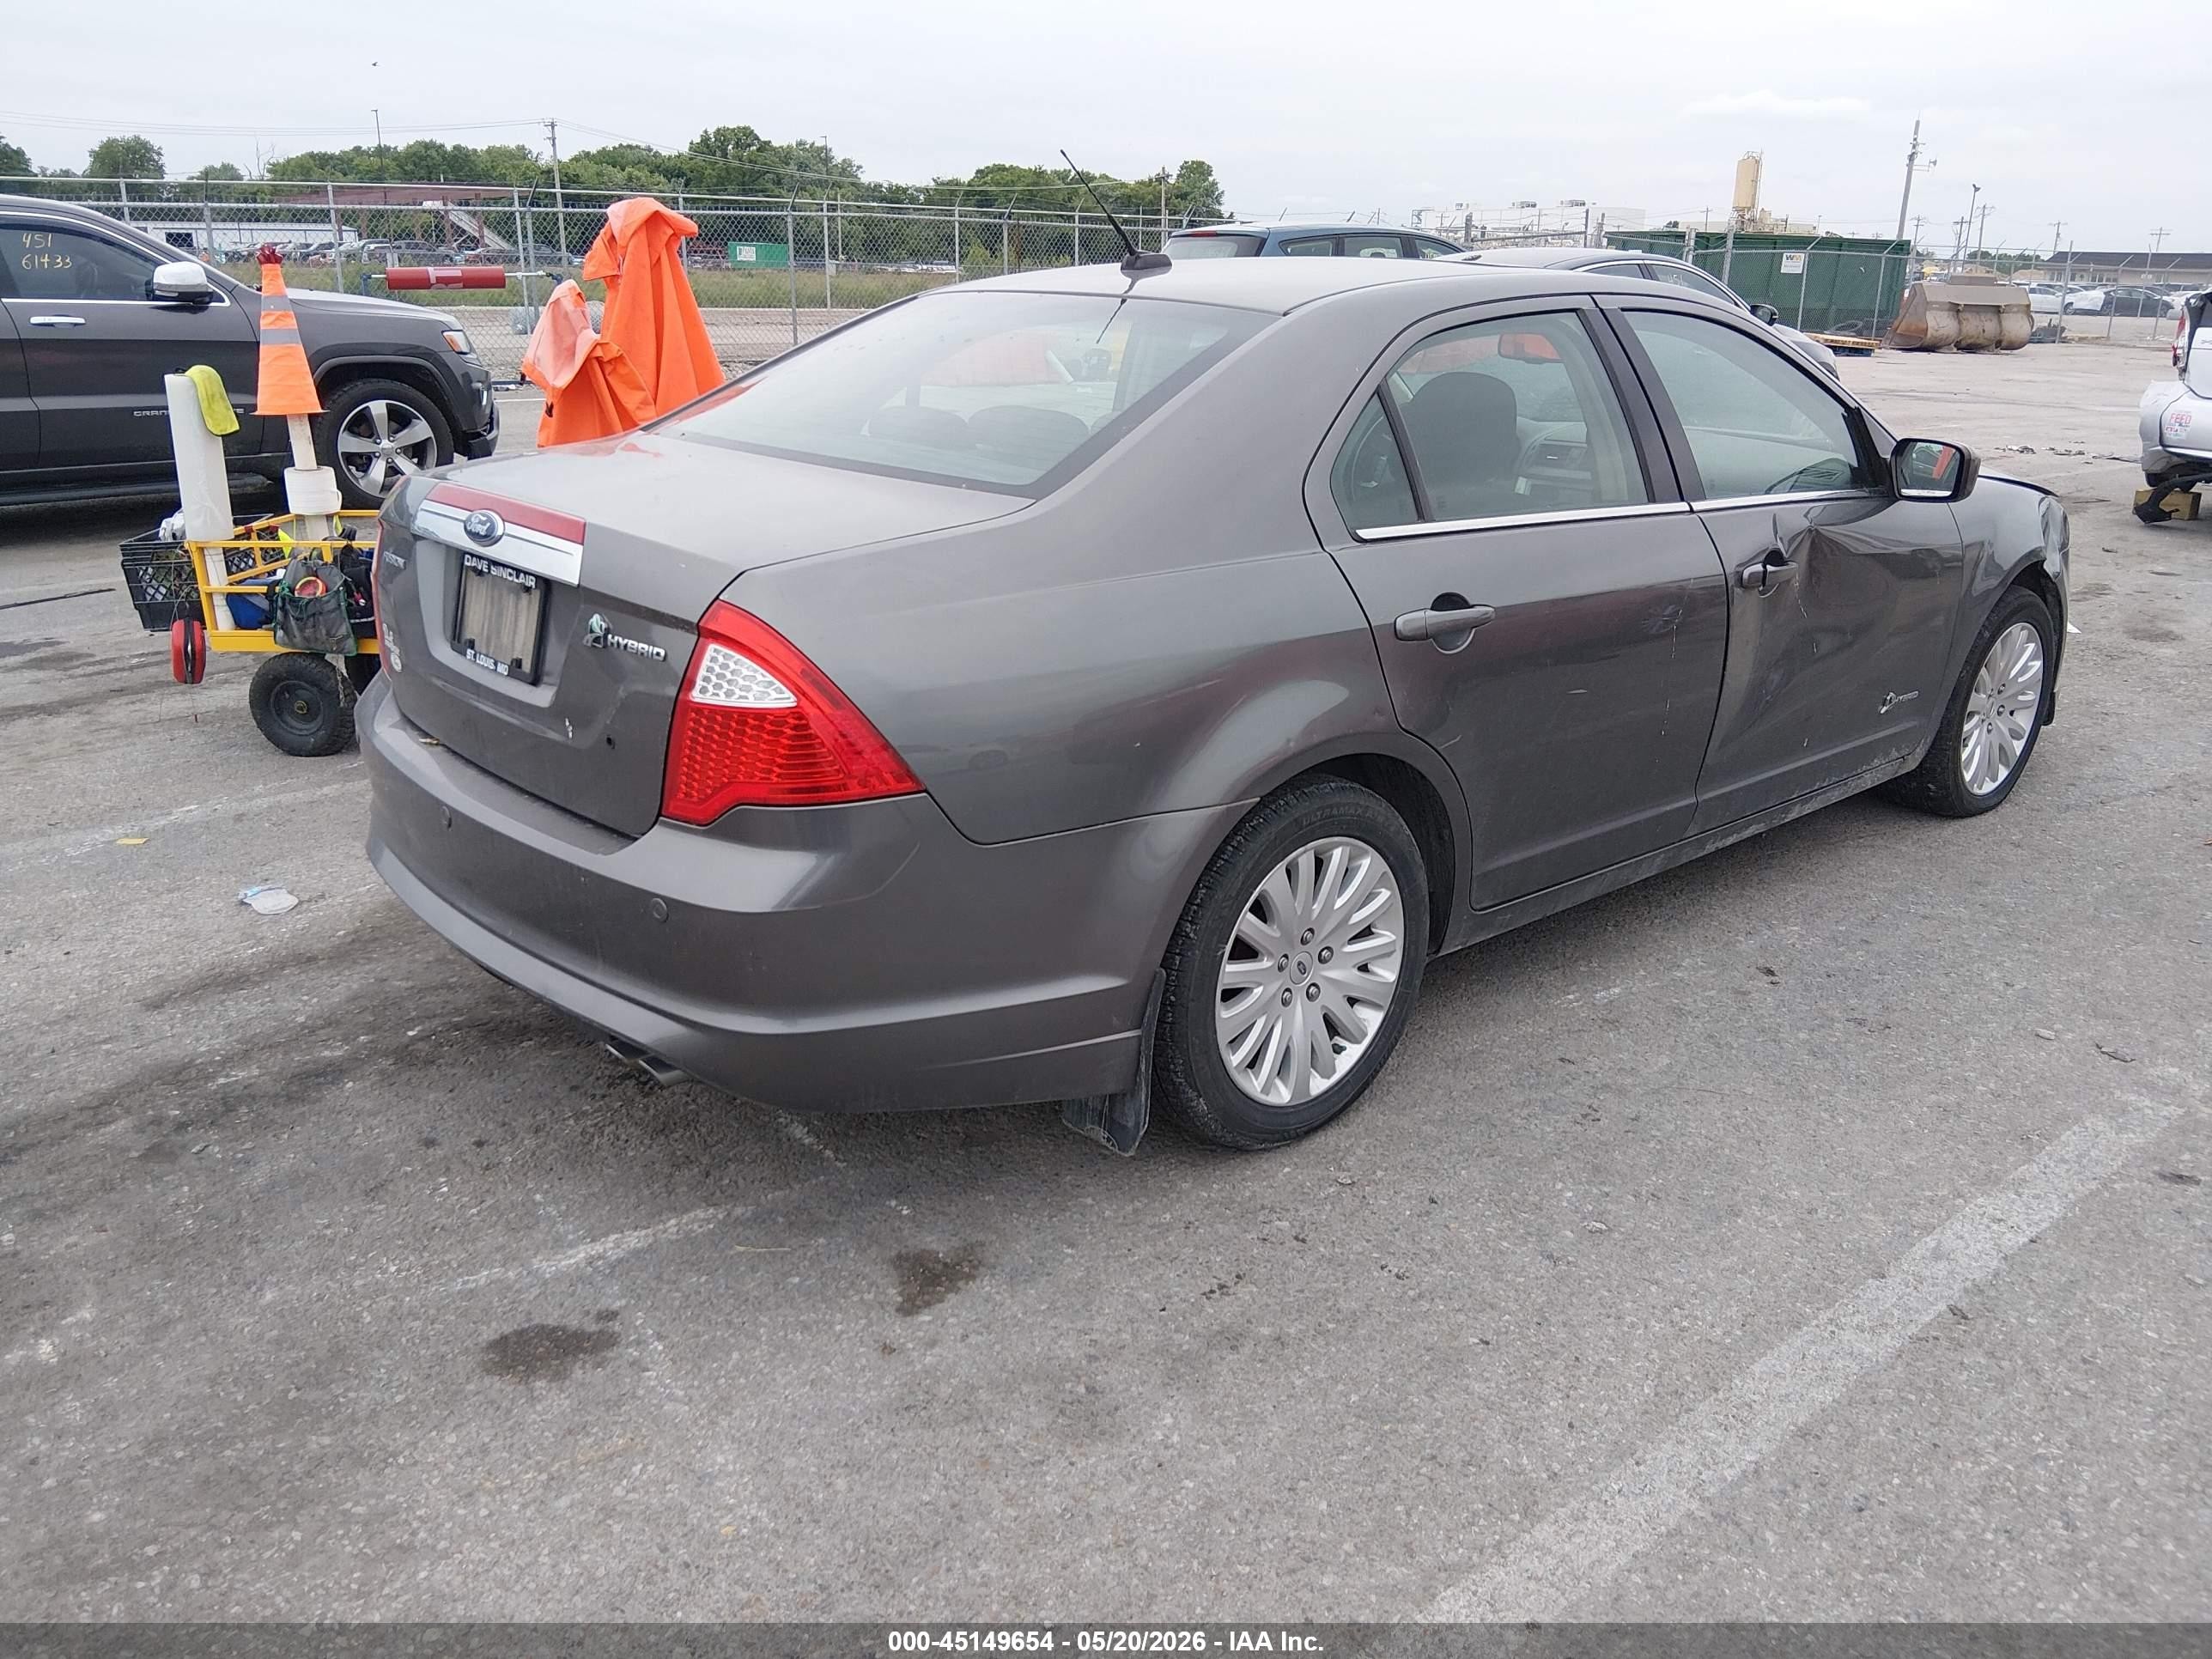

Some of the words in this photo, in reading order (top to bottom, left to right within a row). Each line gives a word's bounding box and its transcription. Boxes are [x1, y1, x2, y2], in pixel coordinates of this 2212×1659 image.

[22, 233, 52, 248] 451
[21, 253, 72, 270] 61433
[466, 514, 491, 537] Ford
[464, 554, 489, 574] DAVE
[489, 564, 536, 589] SINCLAIR
[607, 634, 665, 662] HYBRID
